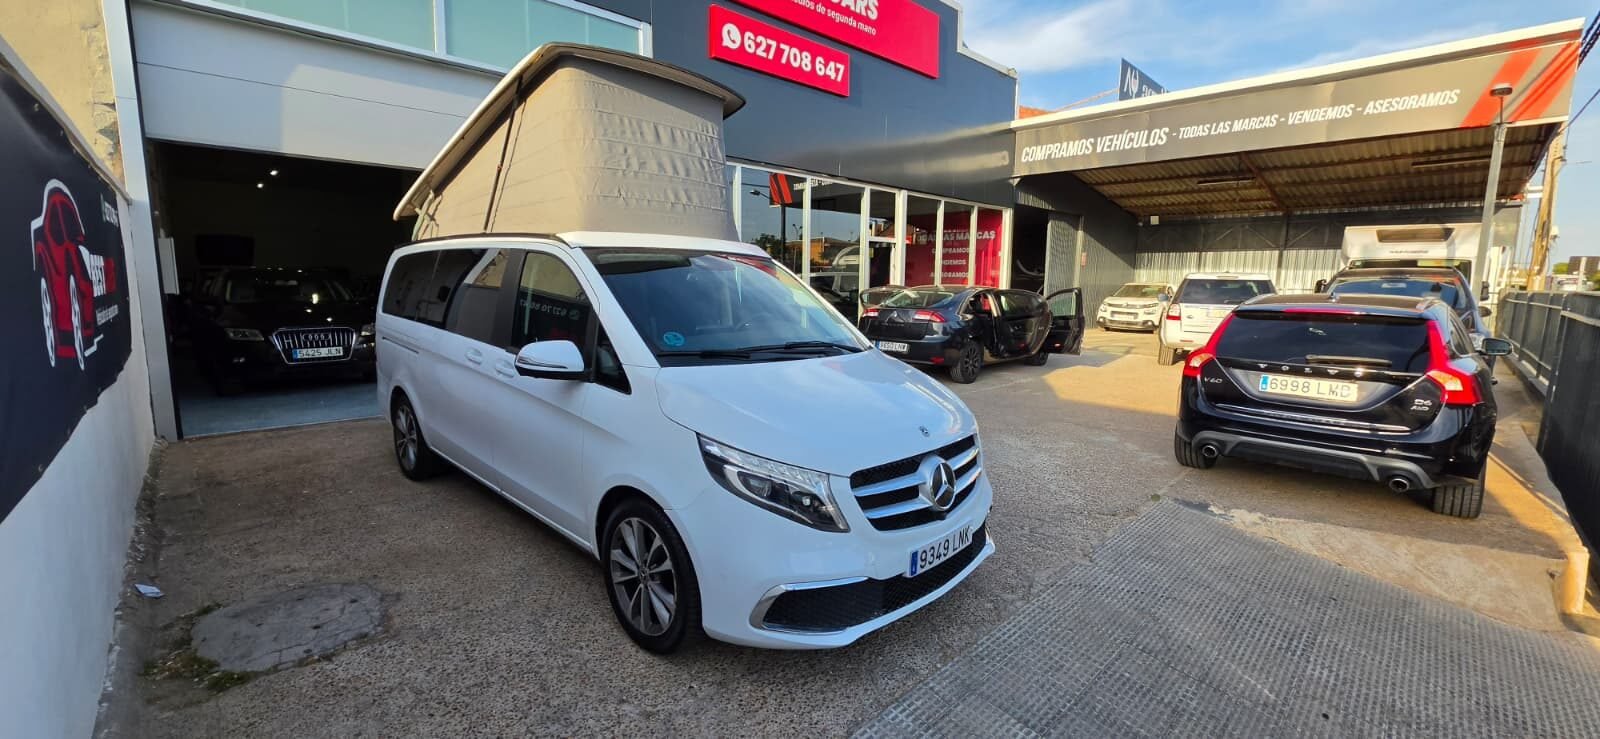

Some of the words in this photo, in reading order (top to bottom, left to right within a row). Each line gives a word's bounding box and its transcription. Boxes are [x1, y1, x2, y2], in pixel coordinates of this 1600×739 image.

[816, 3, 826, 15] de
[826, 9, 857, 28] segunda
[857, 21, 877, 36] mano
[831, 0, 879, 20] ARS
[743, 31, 777, 60] 627
[779, 43, 812, 73] 708
[815, 56, 845, 82] 647
[1021, 138, 1095, 162] COMPRAMOS
[1095, 127, 1169, 153] VEHÍCULOS
[1178, 123, 1209, 140] TODAS
[1209, 121, 1231, 136] LAS
[1231, 114, 1278, 133] MARCAS
[1287, 103, 1355, 126] VENDEMOS
[1363, 89, 1462, 116] ASESORAMOS
[956, 230, 997, 241] MACAS
[1259, 363, 1362, 378] VOLVO
[1270, 378, 1310, 394] 6998
[920, 539, 950, 569] 9349
[952, 524, 970, 552] LNK
